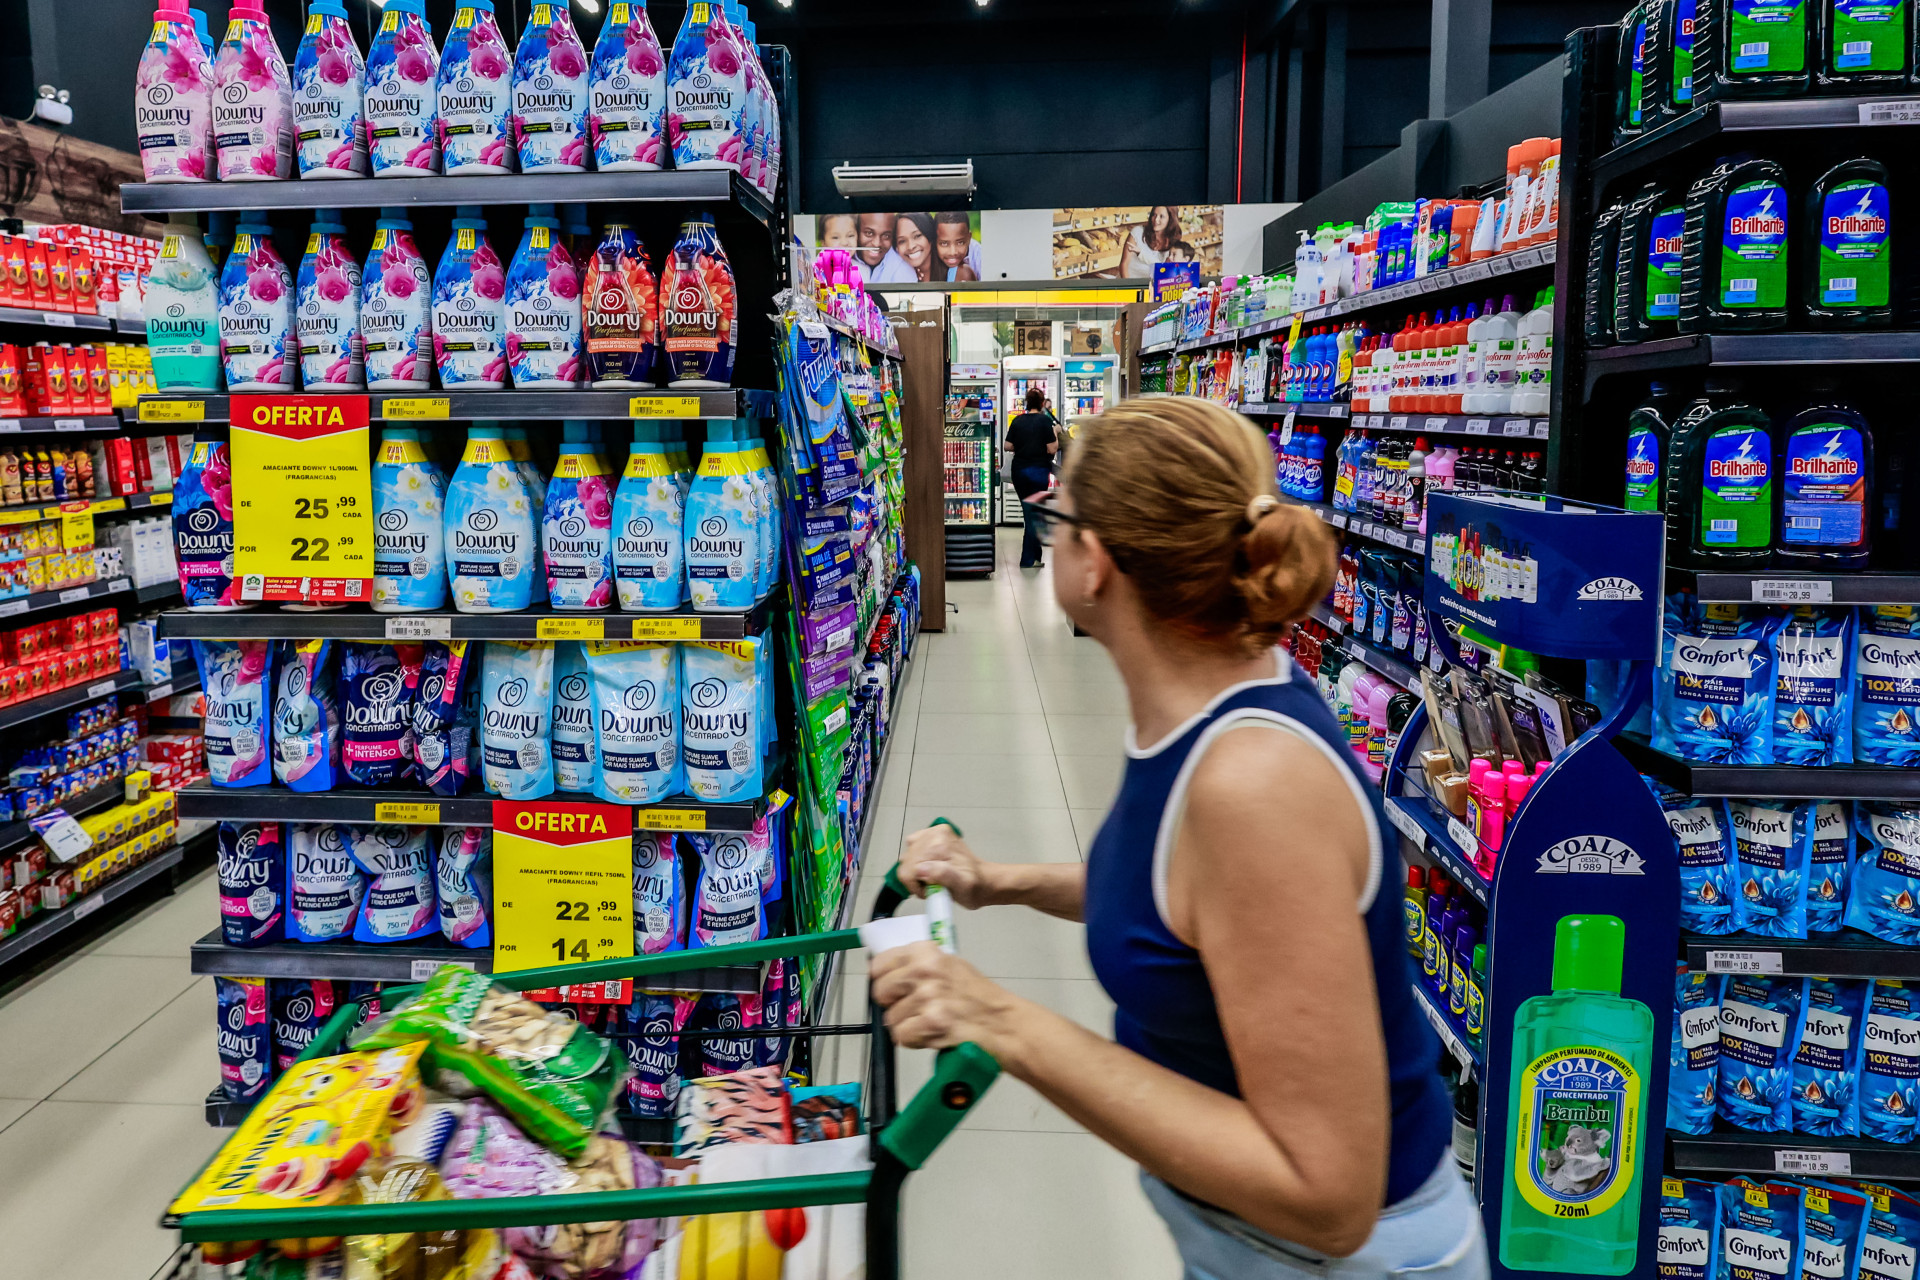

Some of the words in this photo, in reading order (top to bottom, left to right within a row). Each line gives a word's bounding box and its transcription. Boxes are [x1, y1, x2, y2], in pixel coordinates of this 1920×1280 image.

[368, 98, 420, 117] Downy
[441, 95, 492, 111] Downy
[518, 94, 572, 110] Downy
[595, 93, 649, 110] Downy
[676, 91, 731, 109] Downy
[139, 107, 190, 125] Downy
[215, 105, 263, 124] Downy
[295, 101, 341, 118] Downy
[1731, 217, 1784, 235] Brilhante
[1829, 216, 1885, 235] Brilhante
[151, 319, 204, 337] Downy
[221, 317, 271, 335] Downy
[297, 317, 338, 334] Downy
[362, 314, 404, 333] Downy
[438, 312, 496, 331] Downy
[514, 311, 570, 331] Downy
[587, 310, 640, 331] Downy
[665, 310, 718, 330] Downy
[594, 327, 625, 336] Perfume
[253, 406, 344, 426] OFERTA
[1305, 469, 1321, 479] VEJA
[1711, 460, 1767, 477] Brilhante
[1793, 458, 1857, 474] Brilhante
[295, 498, 329, 518] 25
[291, 538, 329, 561] 22
[456, 531, 515, 553] Downy
[550, 537, 600, 558] Downy
[618, 537, 668, 557] Downy
[691, 537, 742, 557] Downy
[1584, 578, 1635, 595] COALA
[1789, 591, 1810, 600] 20,99
[1440, 596, 1458, 609] Cheirinho
[1467, 609, 1477, 618] rende
[1680, 646, 1744, 666] Comfort
[1679, 676, 1703, 689] 10X
[1704, 685, 1739, 693] PERFUME
[1866, 679, 1895, 692] 10X
[1705, 694, 1738, 702] DURAÇÃO
[602, 710, 672, 737] Downy
[602, 733, 657, 742] CONCENTRADO
[355, 749, 396, 757] INTENSO
[516, 811, 608, 833] OFERTA
[1669, 816, 1711, 835] Comfort
[1732, 812, 1787, 834] Comfort
[1546, 837, 1631, 865] COALA
[1883, 850, 1905, 865] 10X
[1577, 862, 1602, 872] 1989
[1750, 858, 1781, 867] DURAÇÃO
[1881, 863, 1904, 872] LONGA
[547, 878, 599, 886] (FRAGRANCIAS)
[706, 889, 758, 902] CONCENTRADO
[556, 901, 590, 921] 22
[703, 914, 727, 922] PERFUME
[740, 911, 755, 919] DURA
[321, 921, 333, 929] 750
[335, 920, 343, 928] ml
[387, 921, 399, 929] 750
[400, 920, 410, 928] ml
[552, 938, 590, 961] 14
[1740, 962, 1759, 971] 10,99
[1685, 1014, 1719, 1038] Comfort
[1719, 1007, 1780, 1033] Comfort
[218, 1024, 260, 1057] owny
[1721, 1036, 1742, 1050] 10X
[1743, 1042, 1759, 1050] MAIS
[1743, 1048, 1772, 1059] PERFUME
[1810, 1051, 1841, 1061] PERFUME
[1869, 1052, 1890, 1065] 10X
[1531, 1051, 1559, 1072] LIMPADOR
[1560, 1048, 1596, 1057] PERFUMADO
[1605, 1054, 1633, 1077] AMBIENTES
[1813, 1059, 1841, 1069] DURAÇÃO
[1542, 1059, 1617, 1084] COALA
[1553, 1092, 1608, 1100] CONCENTRADO
[1546, 1104, 1610, 1122] Bambu
[214, 1115, 293, 1191] NINHO
[1554, 1204, 1589, 1217] 120ml
[1658, 1236, 1706, 1253] Comfort
[1729, 1237, 1787, 1261] Comfort
[1659, 1265, 1677, 1276] 10X
[1734, 1268, 1754, 1279] 10X
